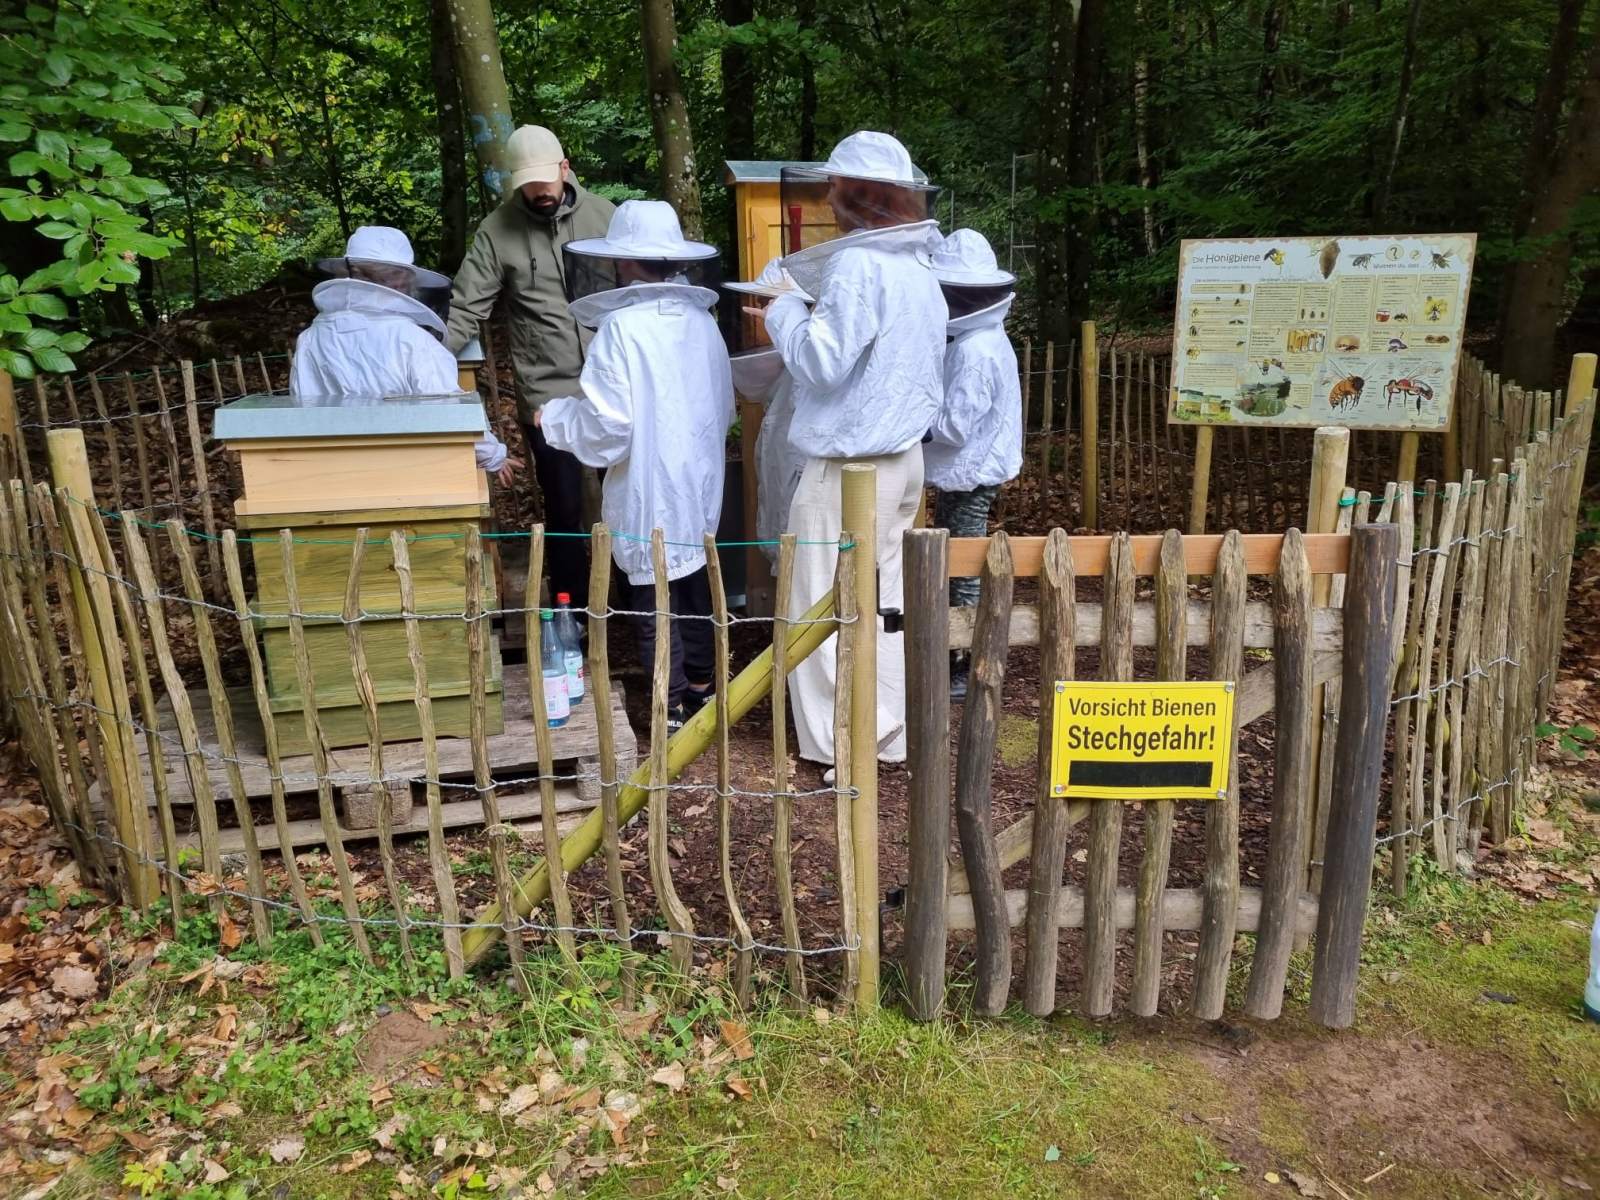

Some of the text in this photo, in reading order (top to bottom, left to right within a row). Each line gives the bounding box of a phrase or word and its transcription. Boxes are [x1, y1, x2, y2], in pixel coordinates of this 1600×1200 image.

[1192, 253, 1261, 264] Die Honigbiene
[1069, 698, 1216, 717] Vorsicht Bienen
[1068, 723, 1215, 757] Stechgefahr!
